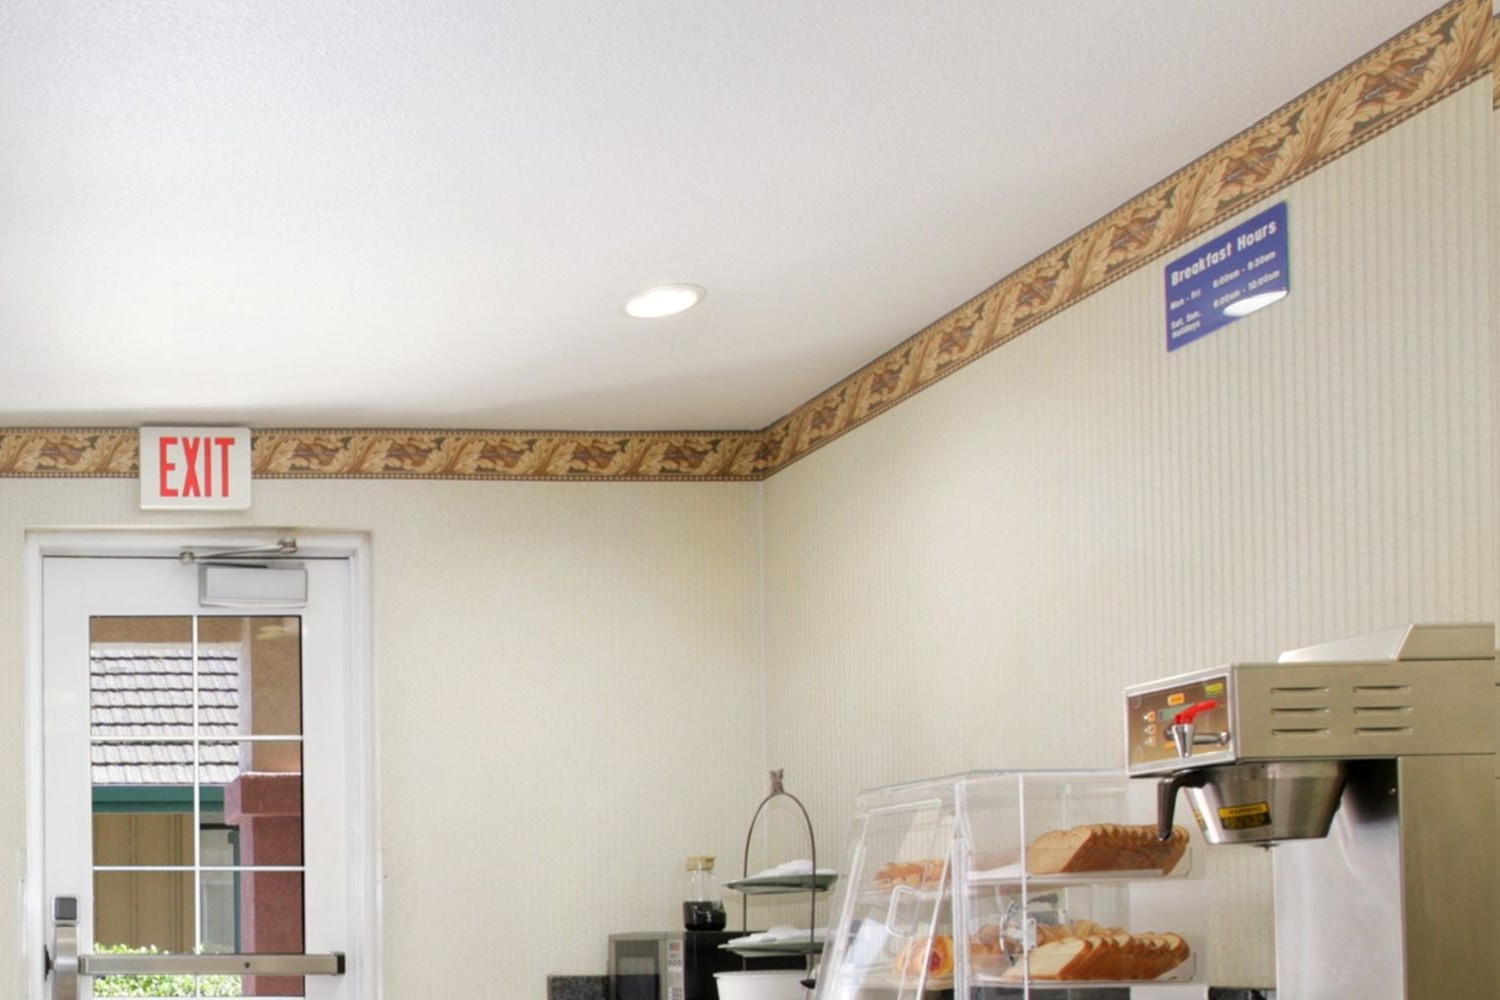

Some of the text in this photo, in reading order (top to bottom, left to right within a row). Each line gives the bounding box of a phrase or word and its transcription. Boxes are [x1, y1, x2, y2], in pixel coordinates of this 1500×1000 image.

[1170, 221, 1277, 287] Breakfast Hours
[159, 437, 235, 497] EXIT
